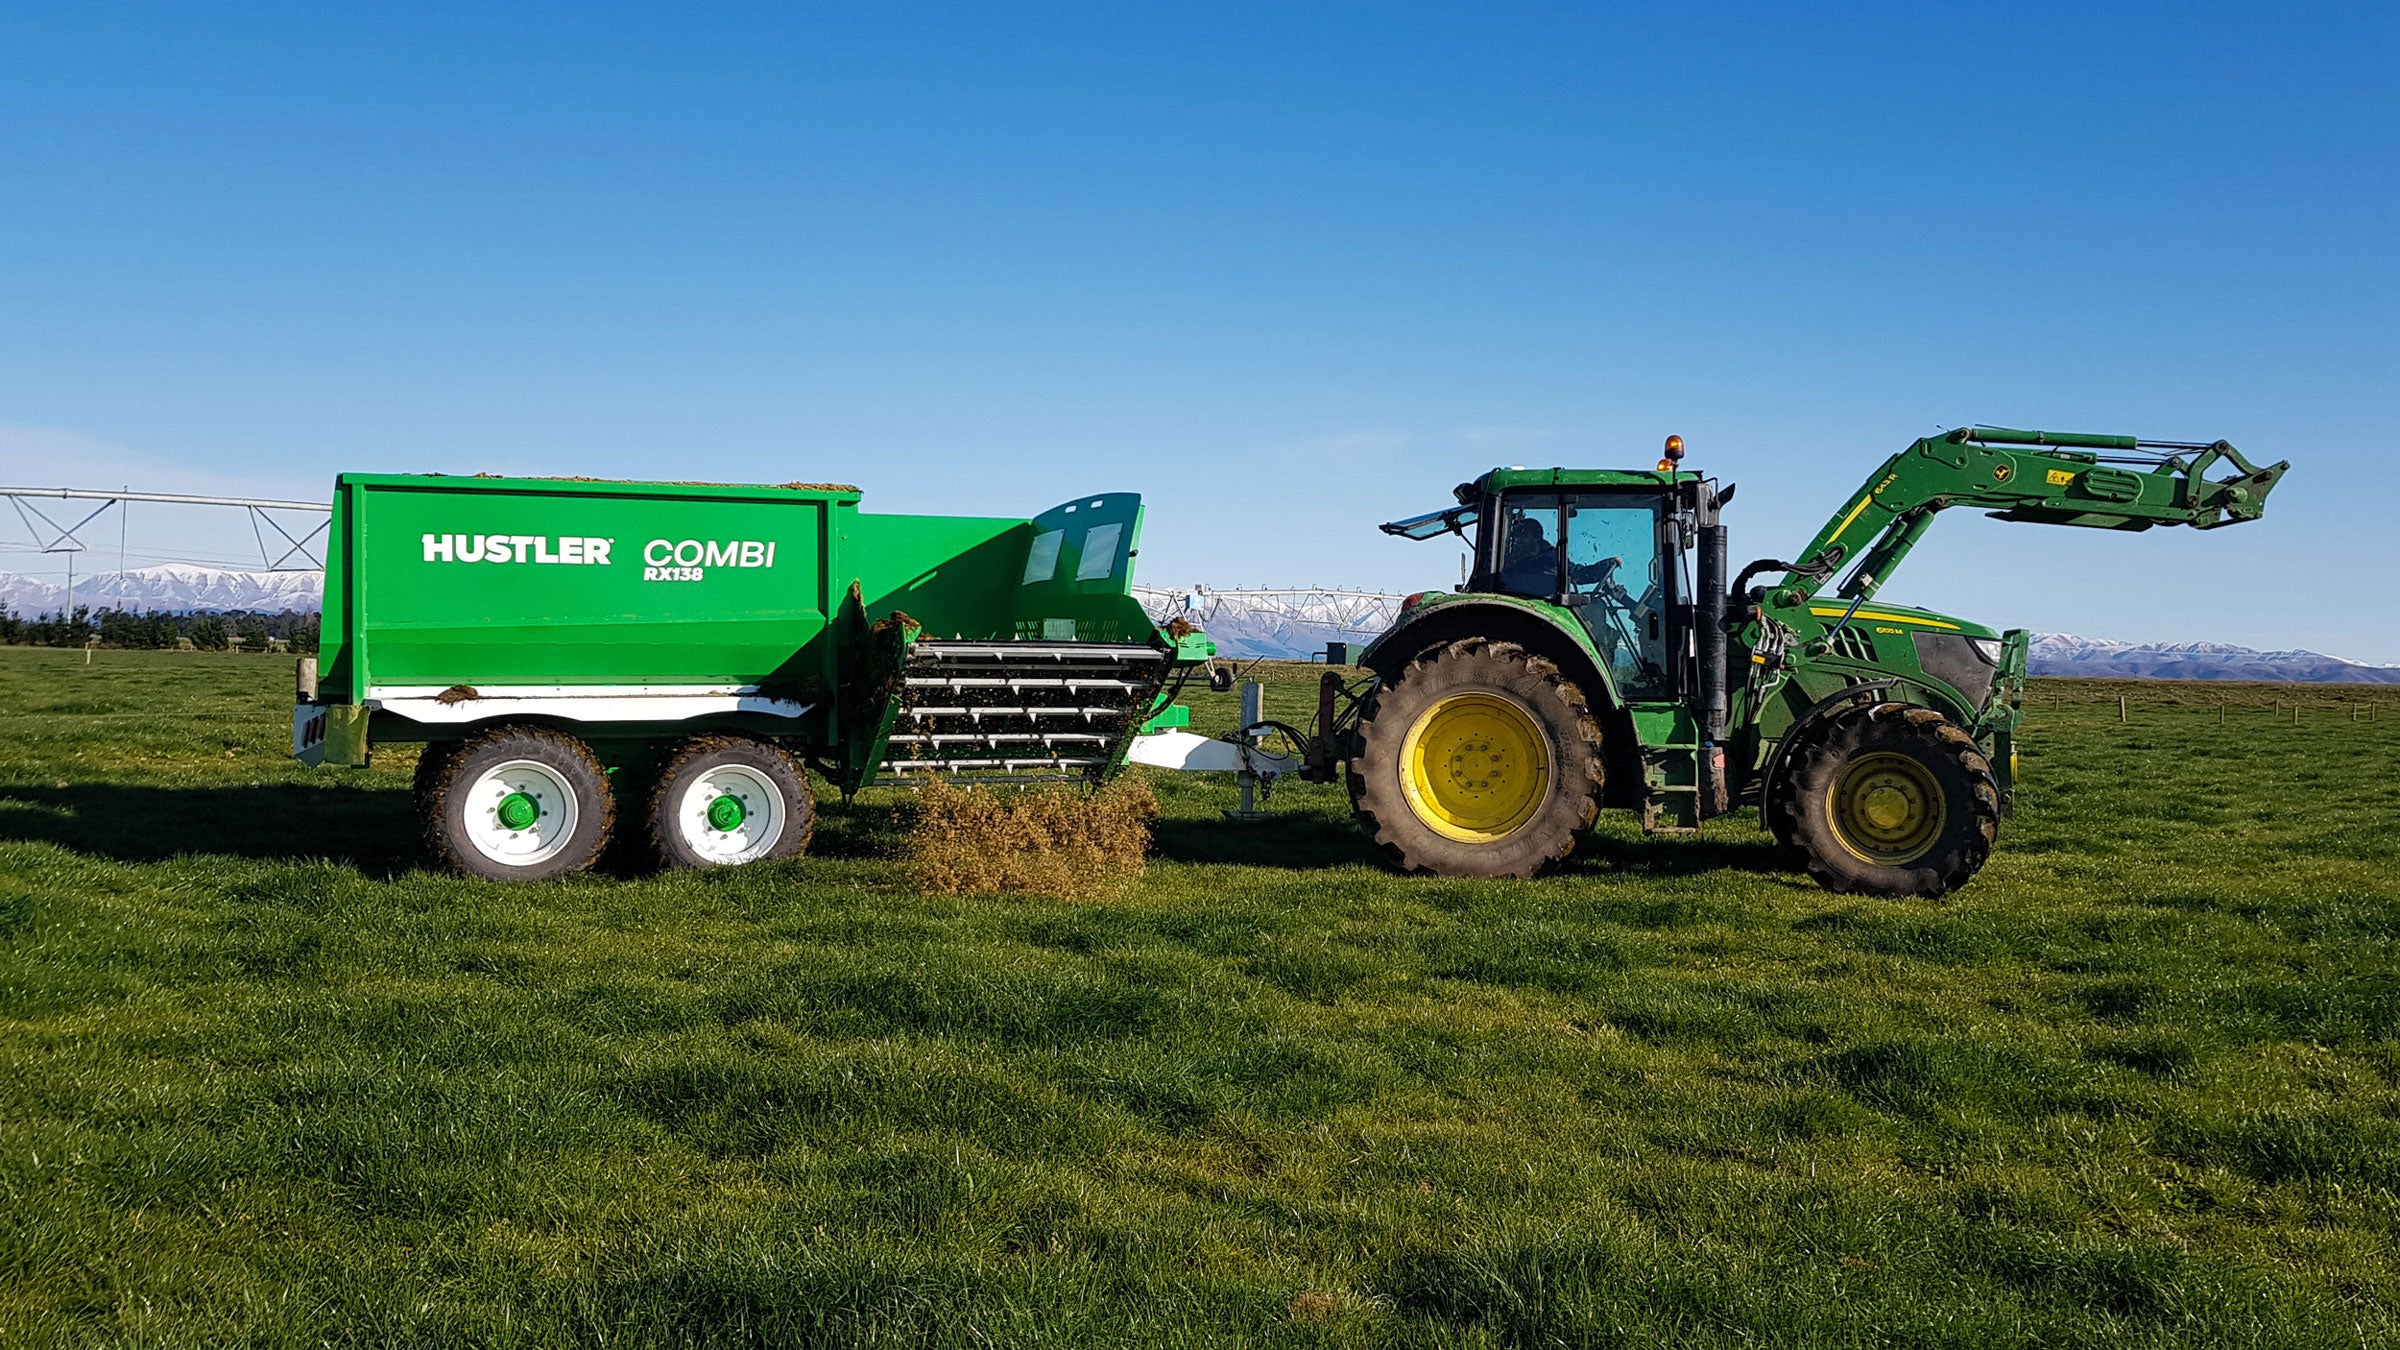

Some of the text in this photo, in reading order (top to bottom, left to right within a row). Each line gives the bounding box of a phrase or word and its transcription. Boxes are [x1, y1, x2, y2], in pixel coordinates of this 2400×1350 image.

[421, 533, 613, 565] HUSTLER
[643, 539, 776, 568] COMBI
[643, 567, 704, 581] RX138
